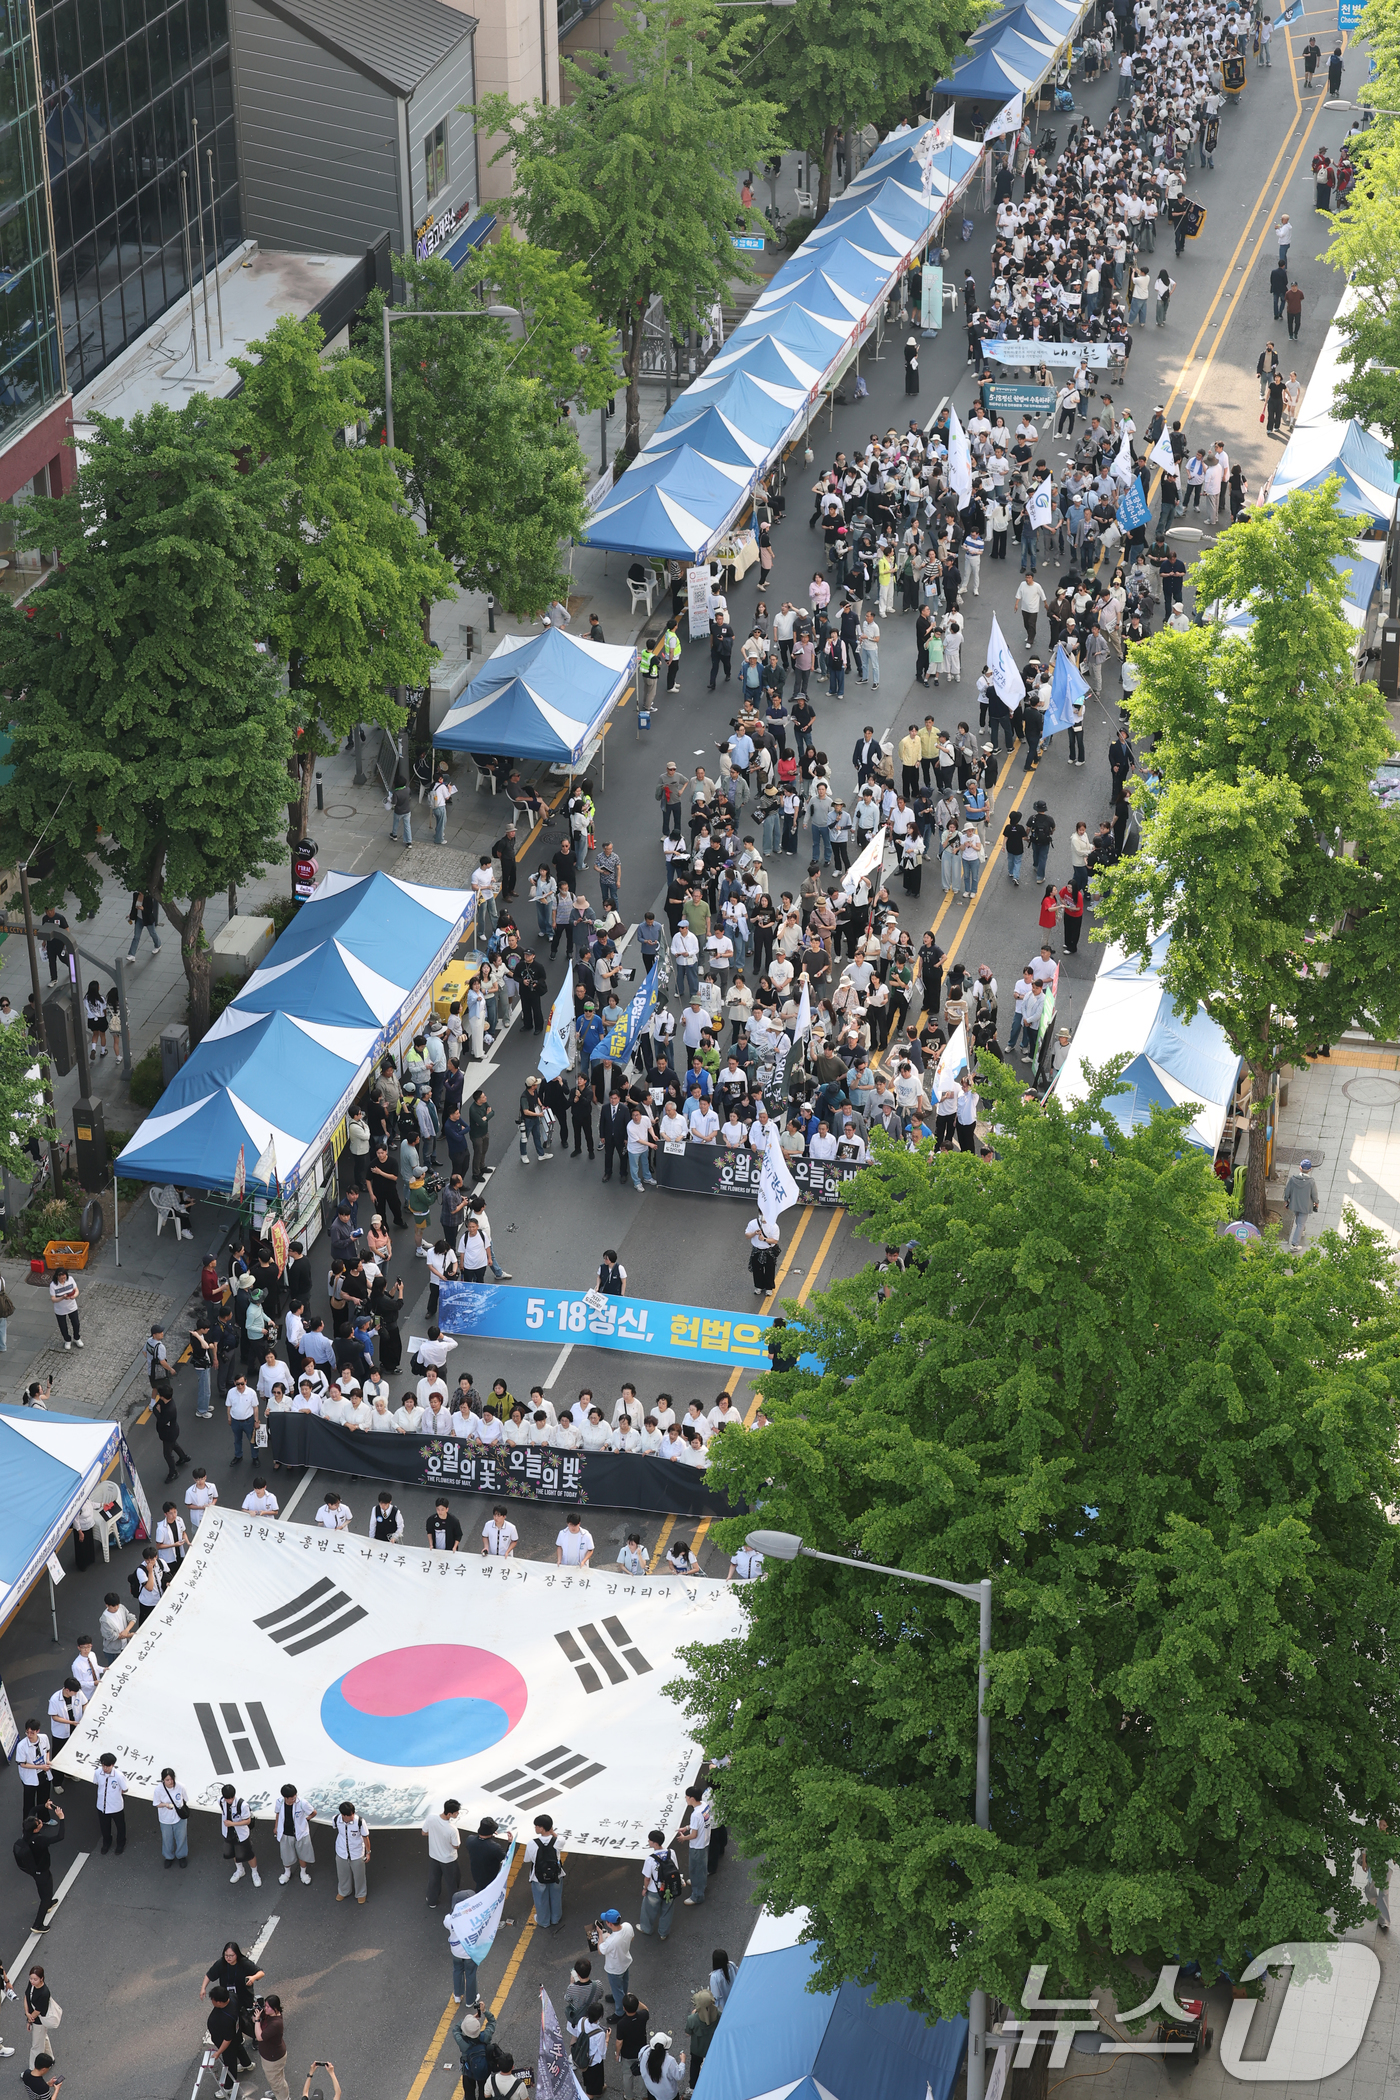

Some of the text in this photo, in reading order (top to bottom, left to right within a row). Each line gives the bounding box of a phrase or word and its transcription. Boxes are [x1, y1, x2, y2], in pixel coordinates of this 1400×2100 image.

[10, 926, 23, 934] CCTV
[795, 1161, 838, 1197] 오늘의
[525, 1298, 769, 1356] 5·18정신, 헌법으
[427, 1441, 581, 1491] 오월의 꽃, 오늘의 빛
[436, 1476, 454, 1485] FLOWERS
[204, 1519, 224, 1554] 이회영
[185, 1559, 208, 1589] 안창호
[242, 1524, 287, 1544] 김원봉
[300, 1536, 345, 1555] 홍범도
[360, 1549, 406, 1567] 나석주
[420, 1560, 467, 1577] 김창숙
[481, 1566, 528, 1582] 백정기
[544, 1575, 591, 1590] 장준하
[606, 1584, 671, 1599] 김마리아
[160, 1592, 189, 1627] 신채호
[138, 1631, 162, 1661] 이상설
[112, 1665, 137, 1698] 이동녕
[86, 1704, 114, 1743] 강우규
[116, 1744, 154, 1766] 이육사
[673, 1749, 693, 1785] 김경천
